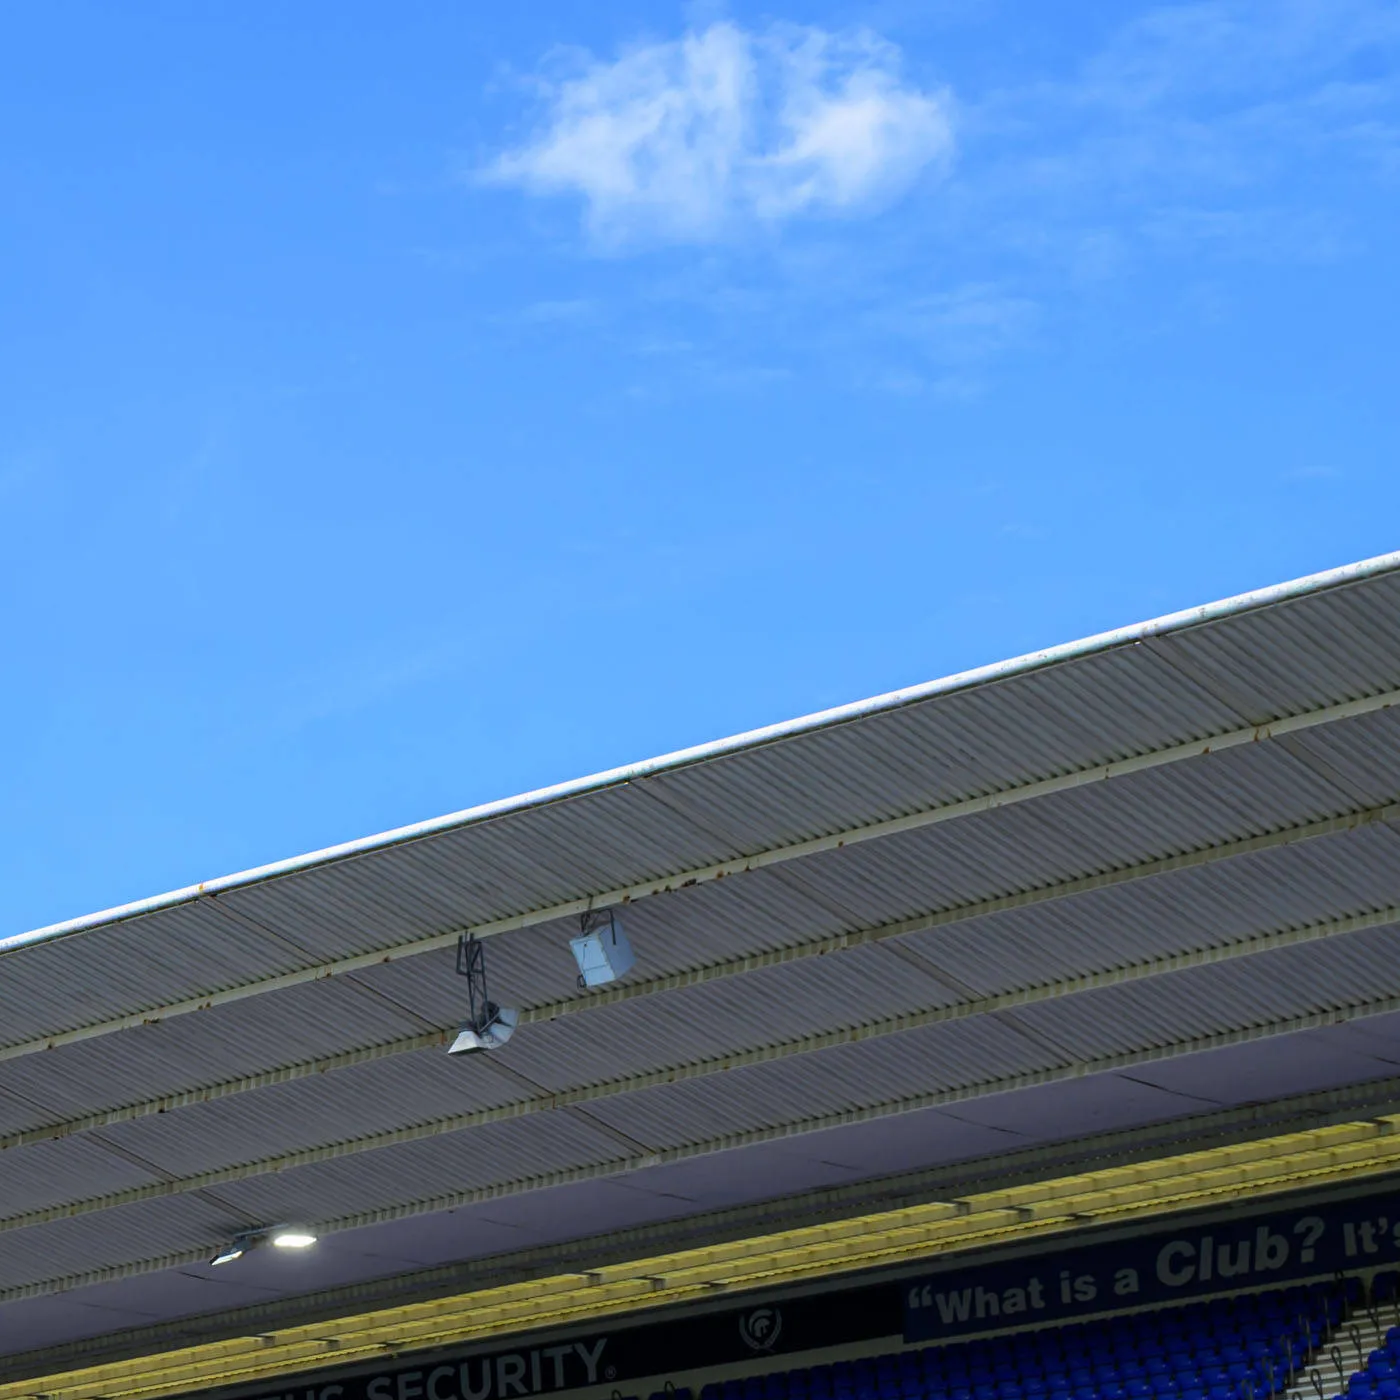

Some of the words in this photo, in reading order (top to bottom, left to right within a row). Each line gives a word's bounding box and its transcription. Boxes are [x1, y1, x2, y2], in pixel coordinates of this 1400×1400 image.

[1060, 1269, 1097, 1305] is
[1114, 1266, 1140, 1296] a
[1155, 1216, 1325, 1288] Club?
